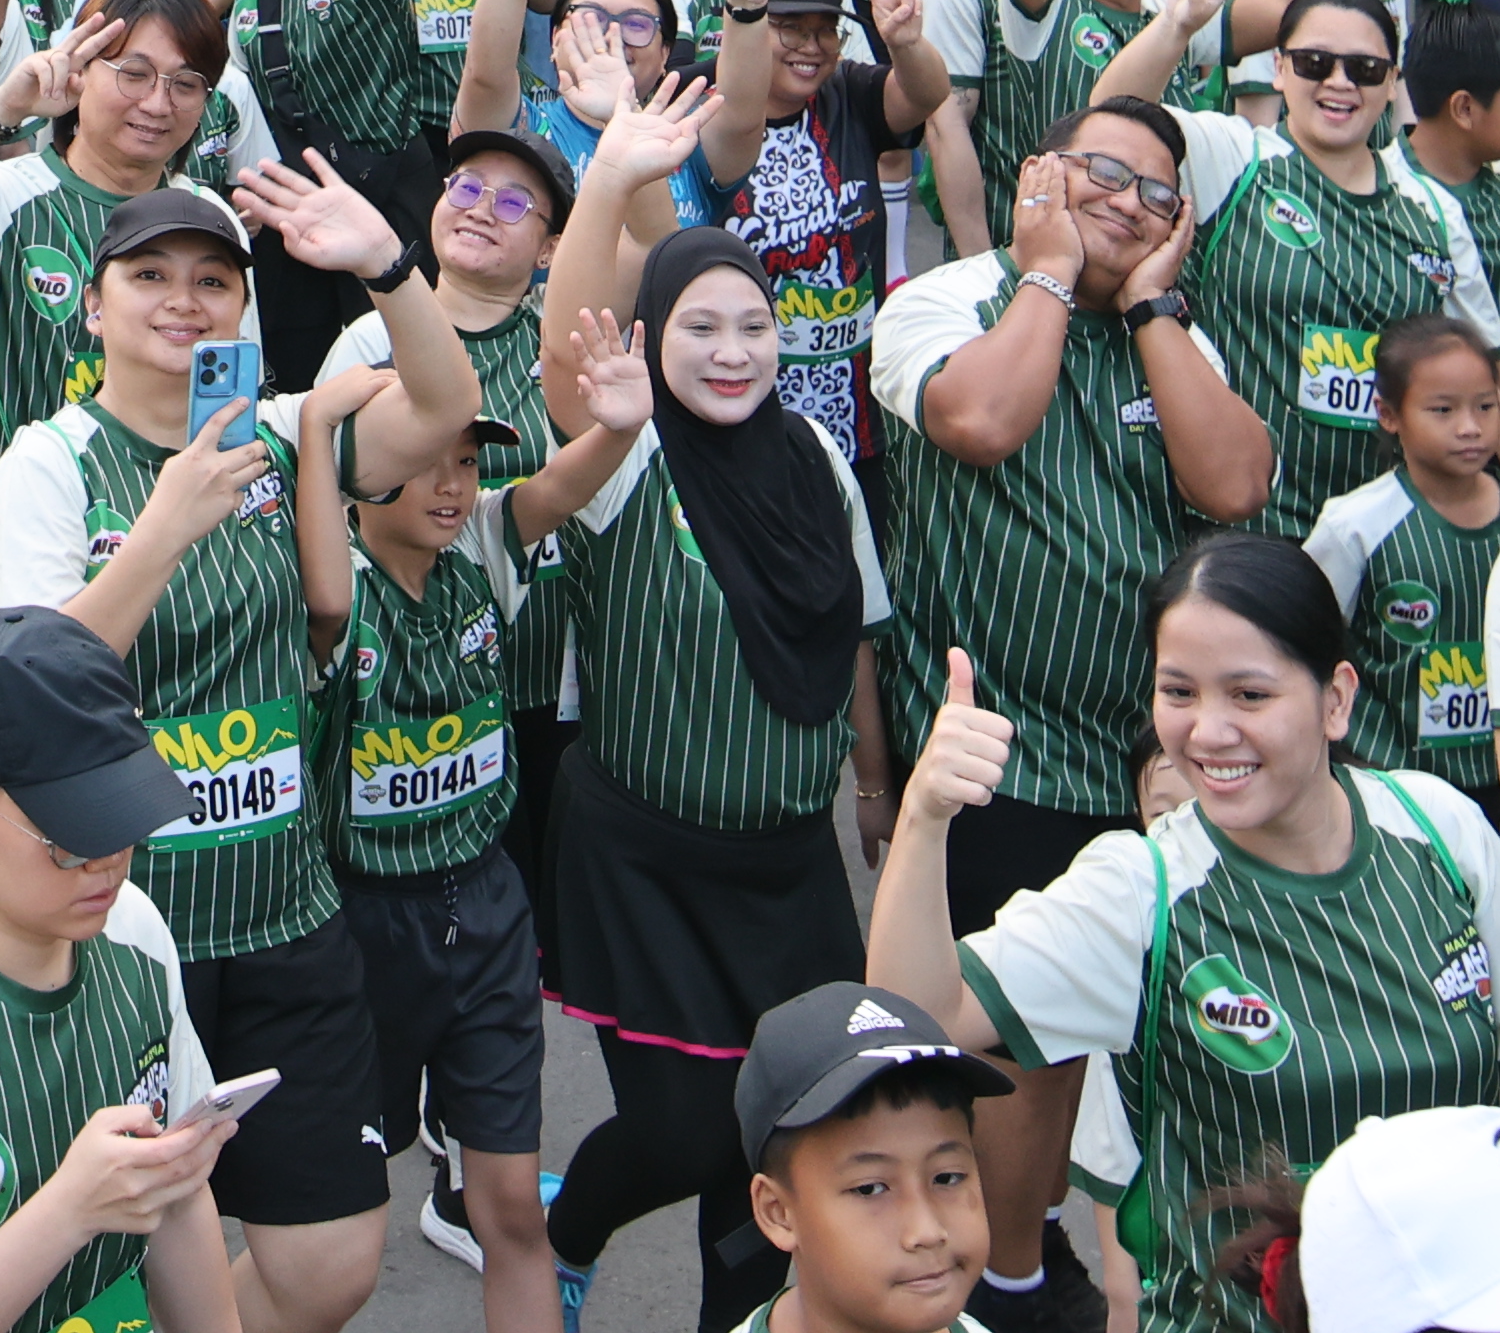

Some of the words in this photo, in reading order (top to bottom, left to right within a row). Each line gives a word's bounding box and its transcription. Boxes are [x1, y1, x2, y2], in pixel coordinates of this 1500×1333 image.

[776, 286, 857, 326] MILO
[809, 318, 859, 352] 3218
[1419, 647, 1487, 699] MIL
[351, 714, 463, 779] MILO
[388, 753, 477, 809] 6014A
[846, 1017, 906, 1034] adidas
[1205, 1002, 1271, 1029] MILO
